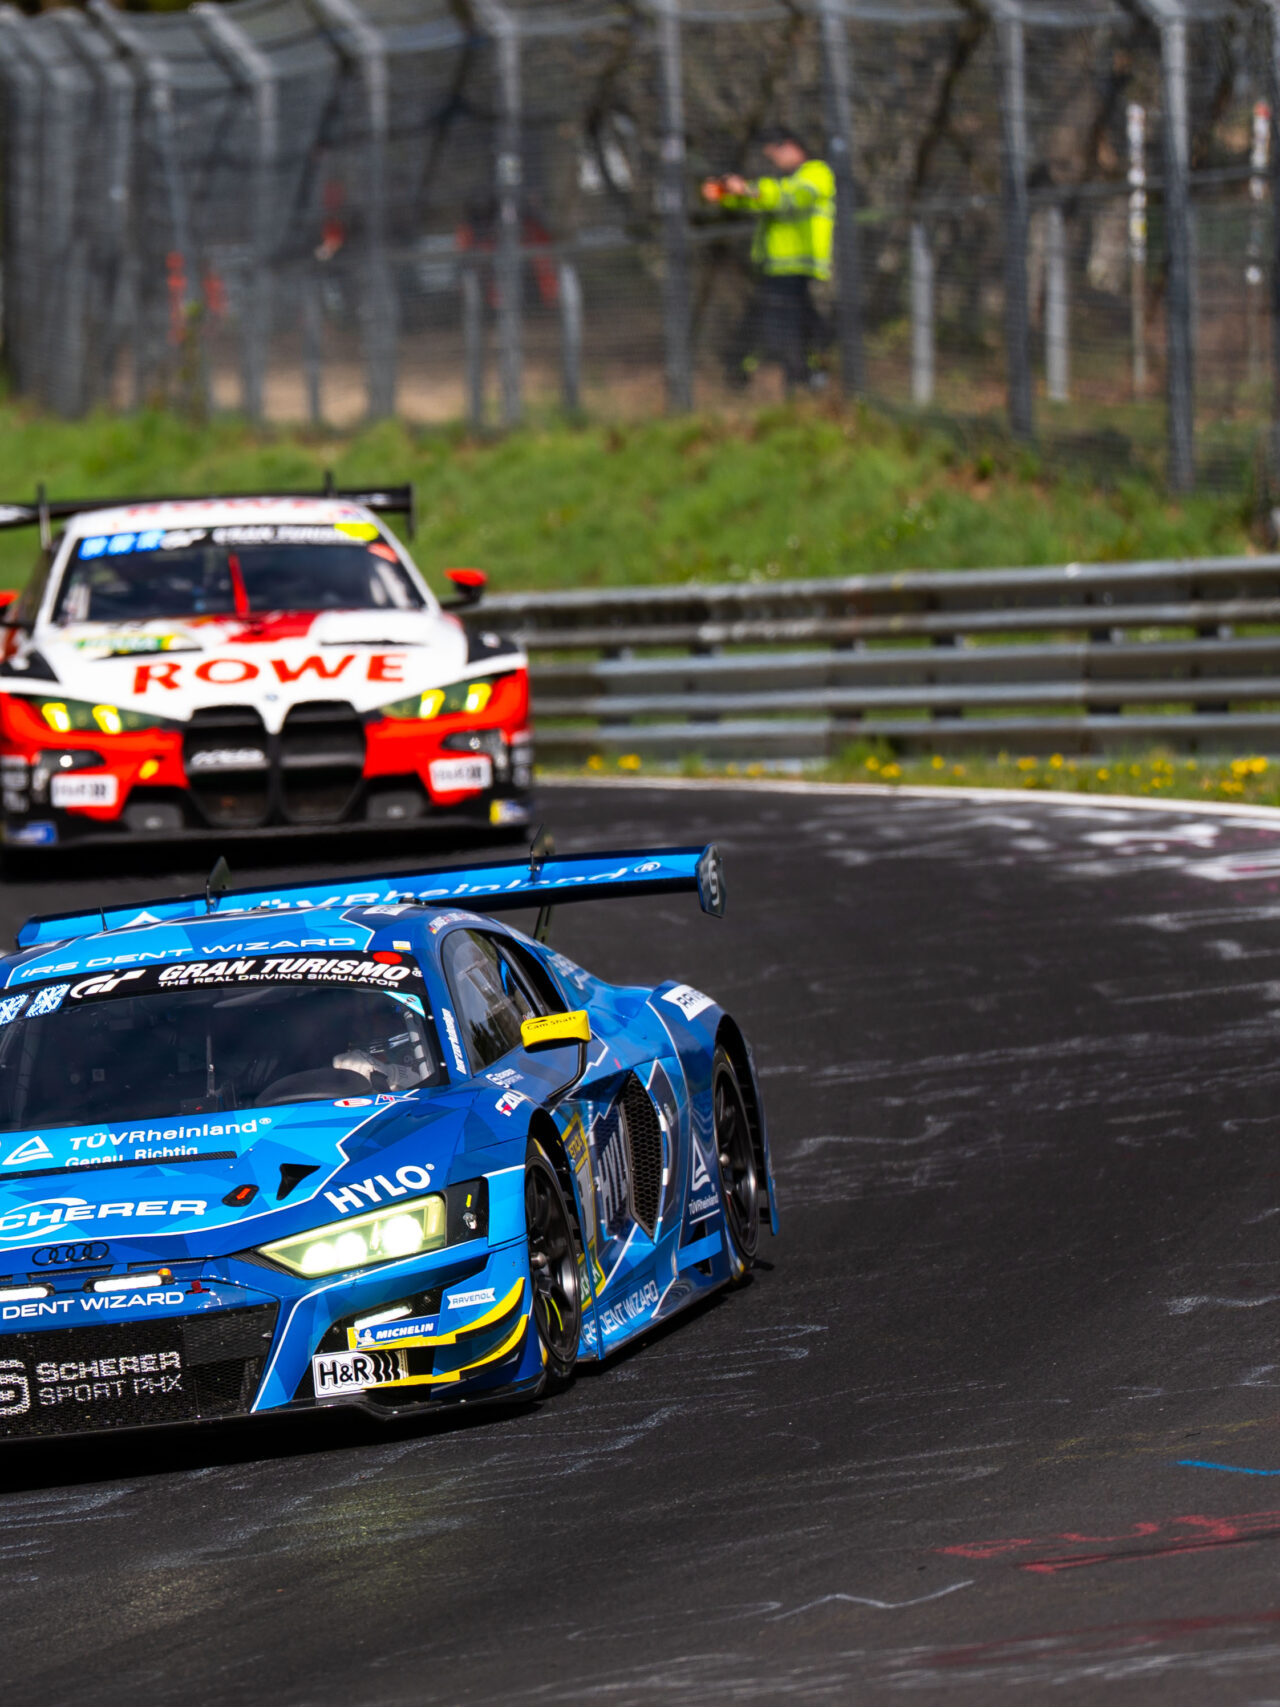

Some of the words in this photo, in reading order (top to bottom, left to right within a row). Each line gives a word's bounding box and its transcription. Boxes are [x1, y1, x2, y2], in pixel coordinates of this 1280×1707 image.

[132, 653, 405, 694] ROWE
[21, 961, 78, 978] IRS
[86, 948, 193, 968] DENT
[202, 937, 356, 954] WIZARD
[158, 960, 257, 981] GRAN
[158, 978, 189, 987] THE
[193, 976, 234, 985] REAL
[238, 973, 303, 981] DRIVING
[307, 973, 400, 988] SIMULATOR
[3, 1299, 76, 1320] DENT
[80, 1291, 185, 1311] WIZARD
[452, 1292, 491, 1304] RAVENOL
[622, 1279, 659, 1319] WIZARD
[376, 1322, 435, 1340] MICHELIN
[35, 1351, 182, 1384] SCHERER
[319, 1357, 370, 1387] H&R
[38, 1379, 127, 1406] SPORT
[133, 1373, 184, 1397] PHX
